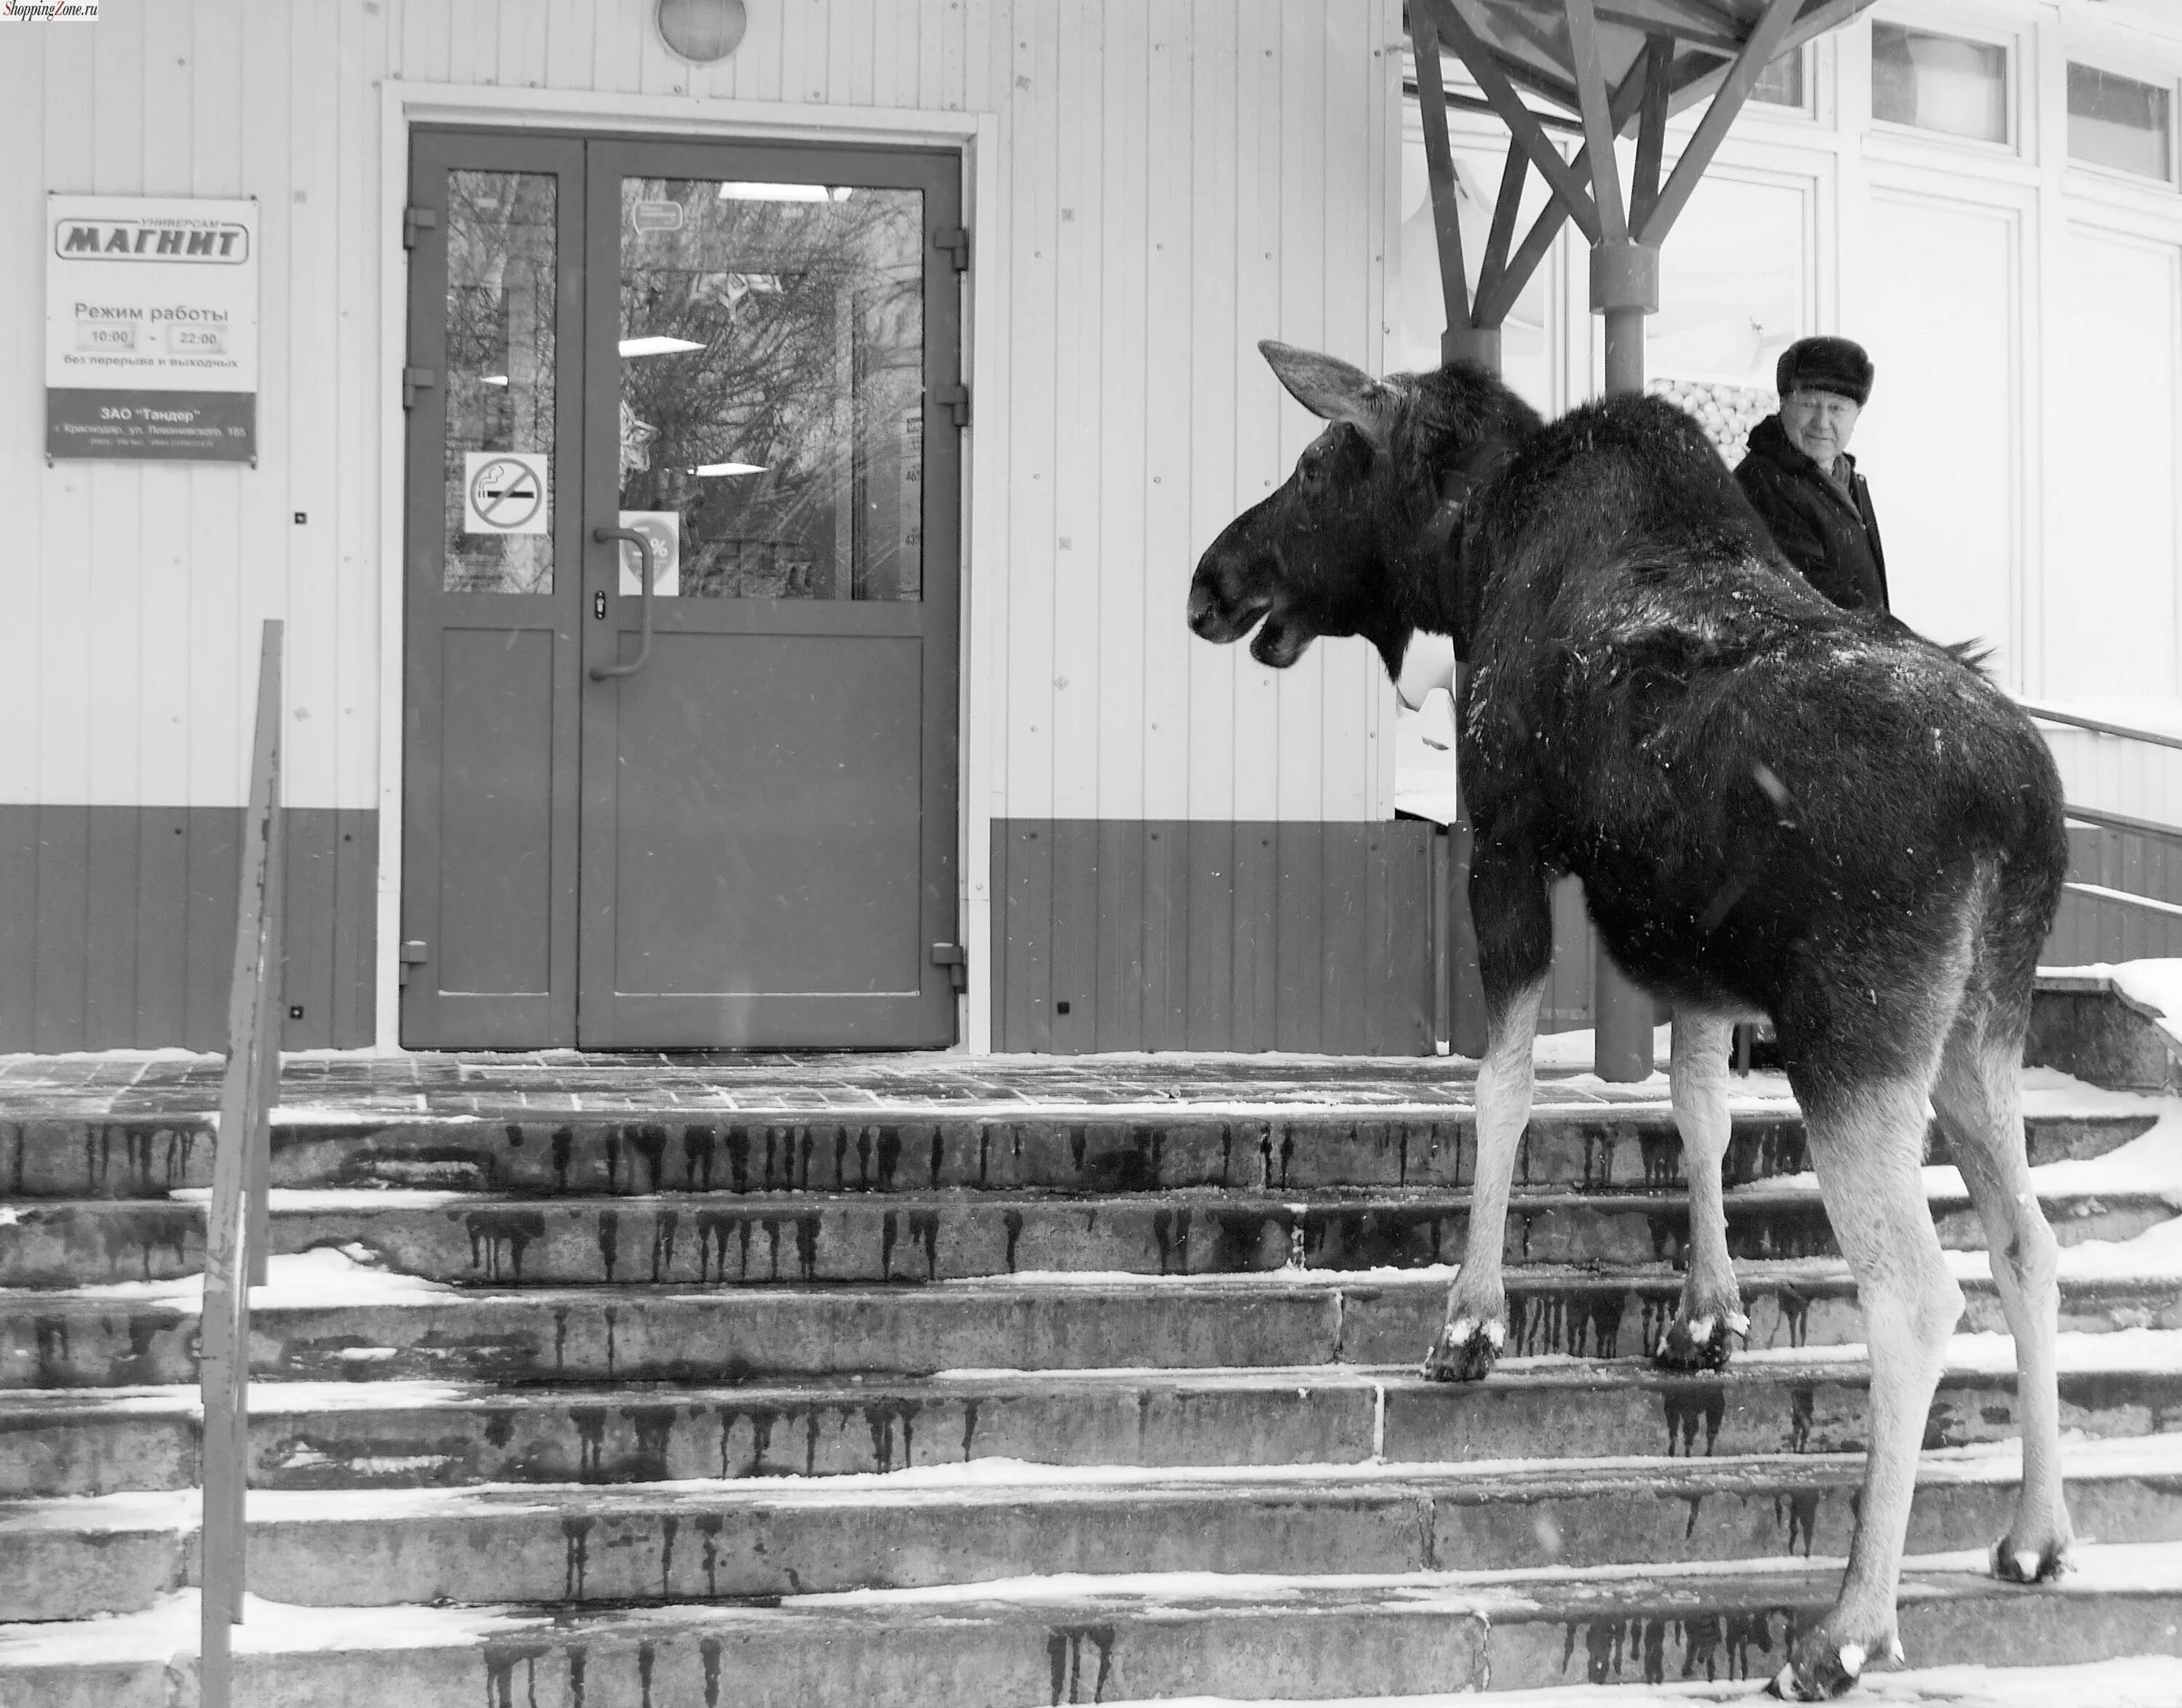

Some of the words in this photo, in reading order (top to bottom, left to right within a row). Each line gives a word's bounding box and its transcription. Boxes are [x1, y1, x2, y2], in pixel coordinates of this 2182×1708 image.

[65, 226, 239, 256] МАГНИТ
[74, 302, 143, 319] Режим
[151, 305, 228, 324] работы
[92, 330, 129, 343] 10:00
[180, 332, 217, 345] 22:00
[63, 354, 87, 365] без
[89, 356, 155, 368] перерыва
[158, 359, 167, 367] и
[169, 359, 239, 369] выходных
[100, 407, 132, 420] ЗАО
